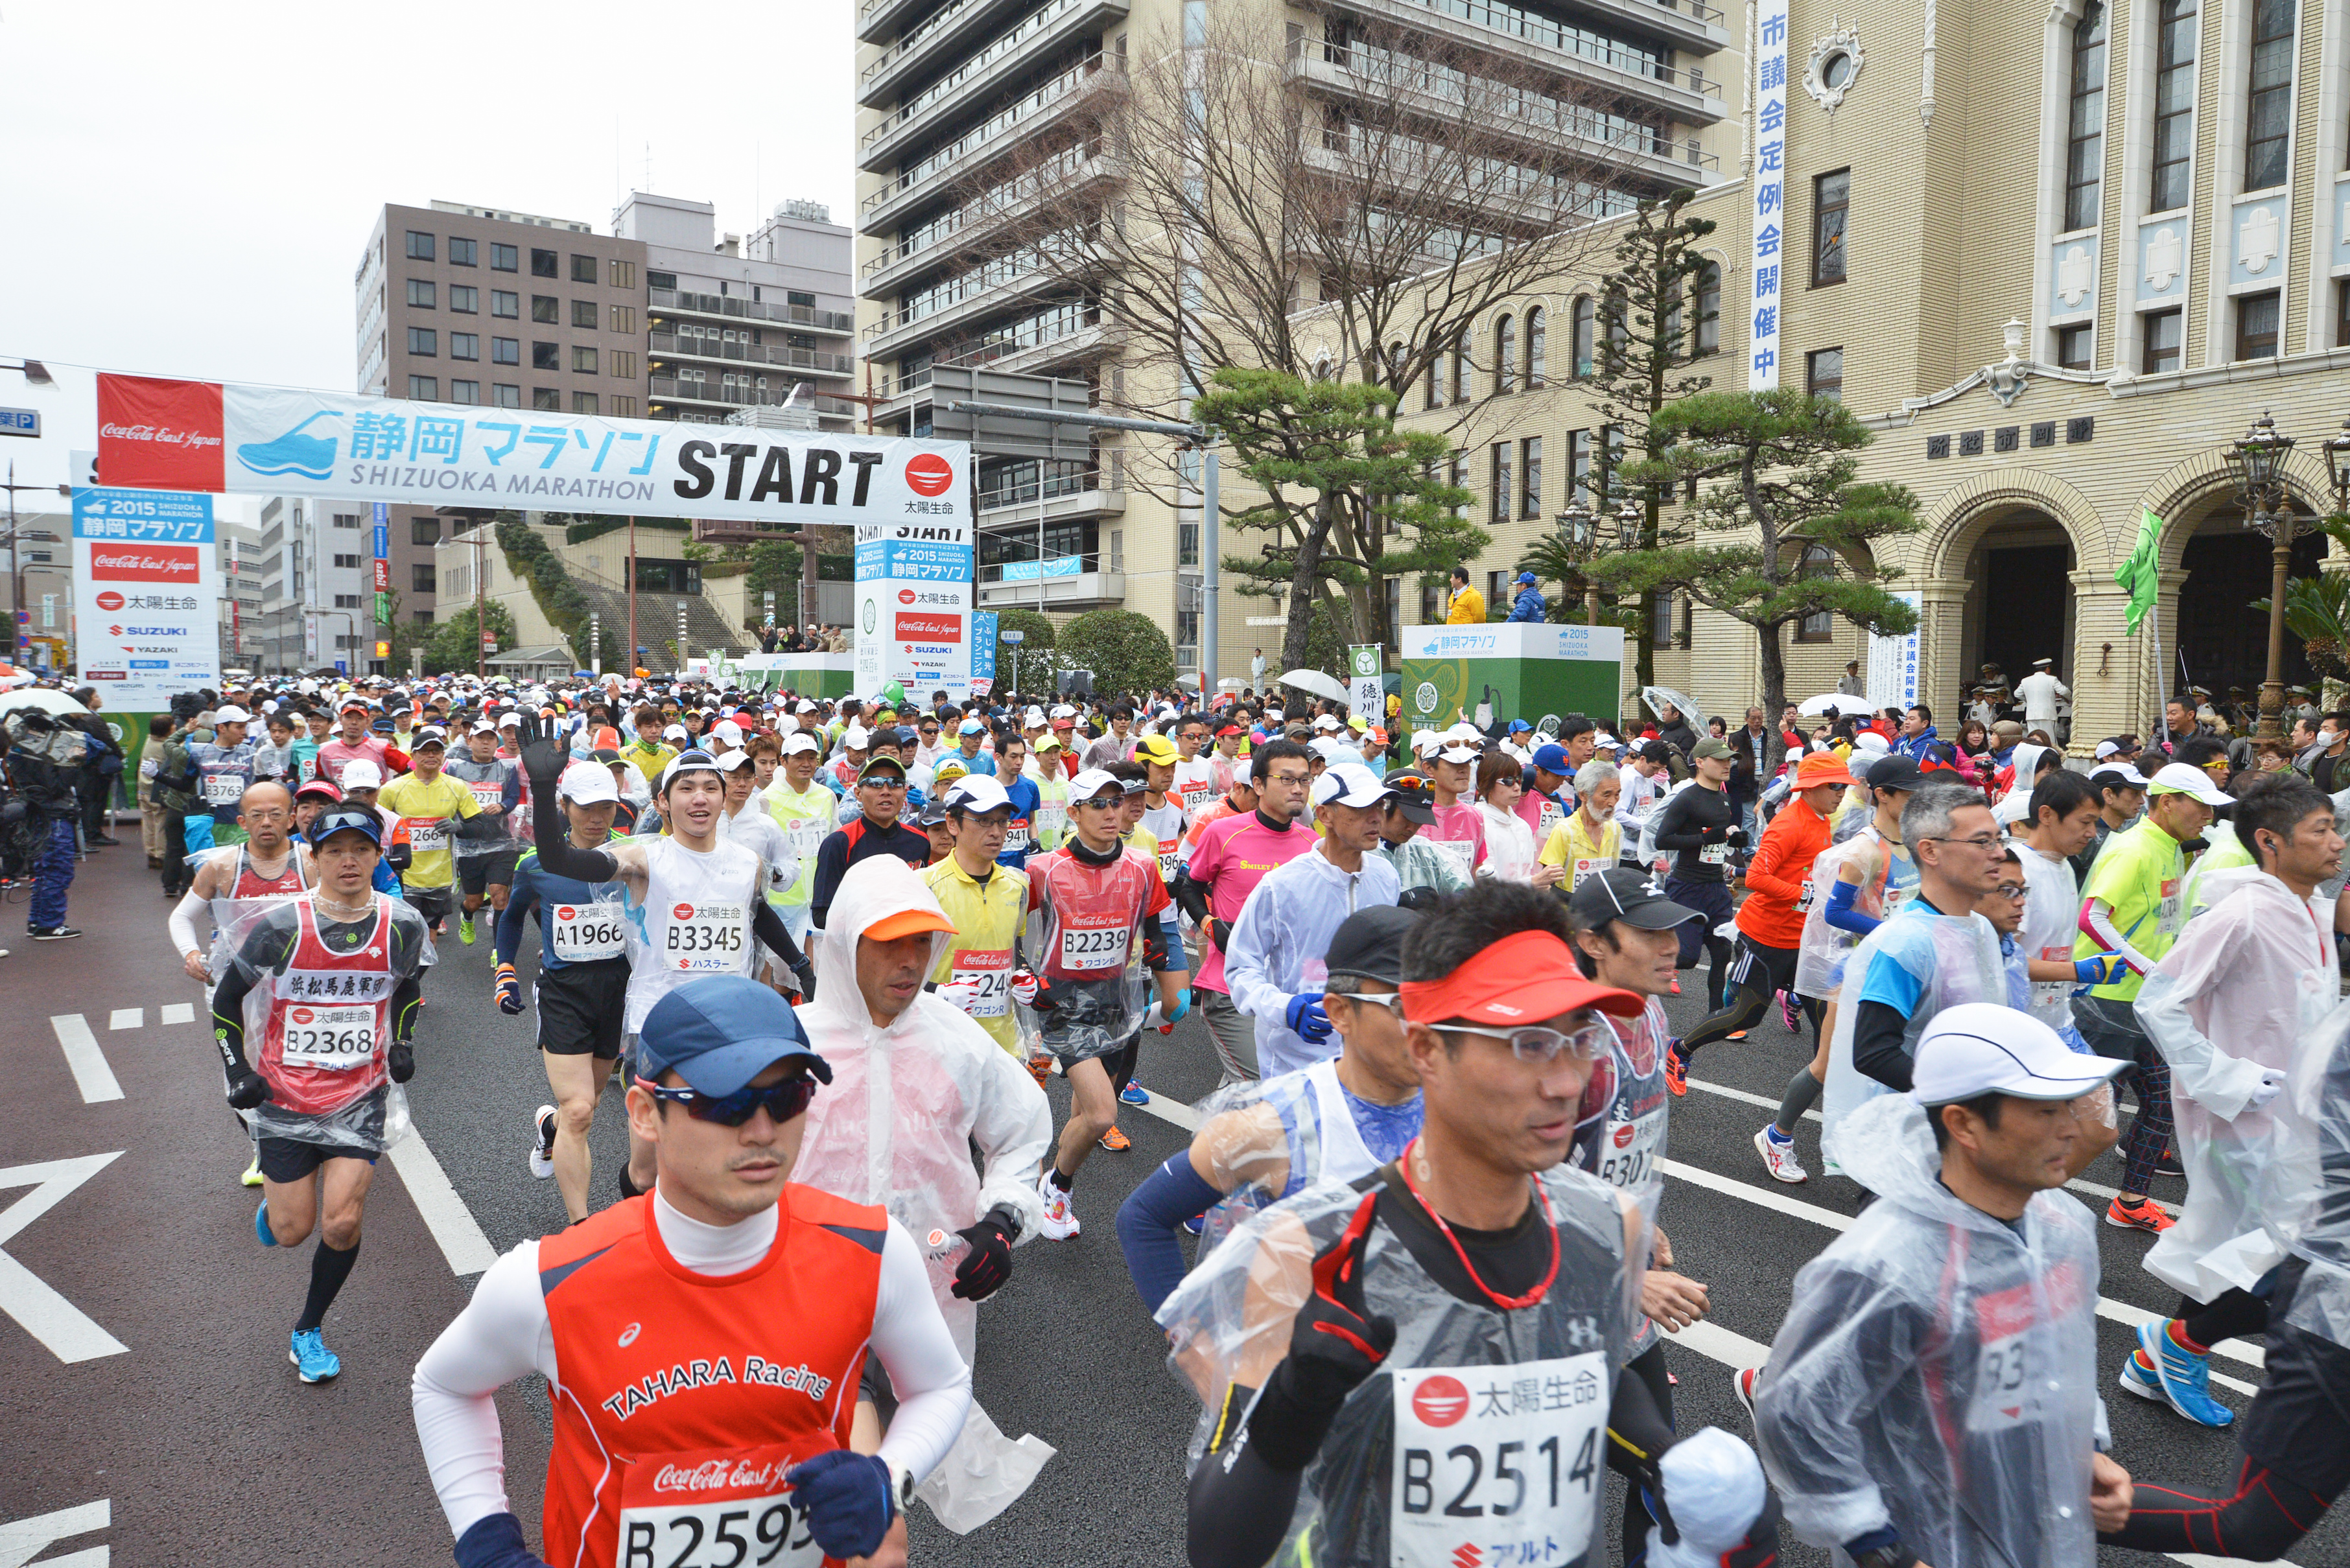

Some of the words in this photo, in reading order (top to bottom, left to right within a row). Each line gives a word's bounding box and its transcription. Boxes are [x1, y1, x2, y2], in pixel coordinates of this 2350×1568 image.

[1754, 14, 1786, 377] 市議会定例会開催中
[20, 414, 31, 427] P
[155, 427, 185, 444] East
[182, 430, 222, 449] Japan
[350, 411, 661, 476] 静岡マラソン
[674, 440, 883, 507] START
[350, 463, 497, 492] SHIZUOKA
[506, 474, 655, 500] MARATHON
[111, 500, 156, 516] 2015
[159, 502, 203, 511] SHIZUOKA
[904, 500, 954, 515] 太陽生命
[82, 516, 204, 539] 静岡マラソン
[863, 550, 873, 563] 2015
[910, 550, 937, 562] 2015
[140, 556, 165, 570] East
[163, 558, 196, 574] Japan
[856, 563, 884, 580] 静岡マラソン
[891, 562, 966, 579] 静岡マラソン
[376, 563, 386, 587] azbil
[128, 595, 198, 610] 太陽生命
[917, 592, 960, 605] 太陽生命
[127, 627, 187, 636] SUZUKI
[925, 622, 940, 633] East
[938, 624, 959, 635] Japan
[1569, 629, 1589, 639] 2015
[984, 626, 993, 672] ふじ観光
[1440, 635, 1496, 649] 静岡マラソン
[974, 627, 982, 676] プランニング
[1411, 723, 1441, 731] 徳川家康公
[207, 785, 242, 796] B3763
[472, 792, 499, 804] 2271
[1182, 791, 1207, 804] 1637
[1004, 830, 1026, 842] 941
[696, 907, 741, 919] 太陽生命
[1094, 914, 1109, 926] East
[1106, 913, 1123, 927] Japan
[556, 924, 623, 946] A1966
[668, 926, 741, 951] B3345
[1064, 930, 1127, 953] B2239
[692, 959, 729, 969] ハスラー
[988, 955, 1002, 965] East
[1085, 957, 1116, 968] ワゴンR
[291, 976, 386, 996] 浜松馬鹿軍団
[954, 972, 1014, 998] 249
[316, 1010, 371, 1024] 太陽生命
[974, 1005, 1004, 1015] ワゴンR
[288, 1029, 373, 1054] B2368
[319, 1061, 349, 1070] アルト
[602, 1356, 736, 1421] TAHARA
[744, 1355, 831, 1402] Racing
[1476, 1369, 1599, 1418] 太陽生命
[729, 1458, 771, 1489] East
[1402, 1427, 1600, 1517] B2514
[1490, 1536, 1559, 1565] アルト
